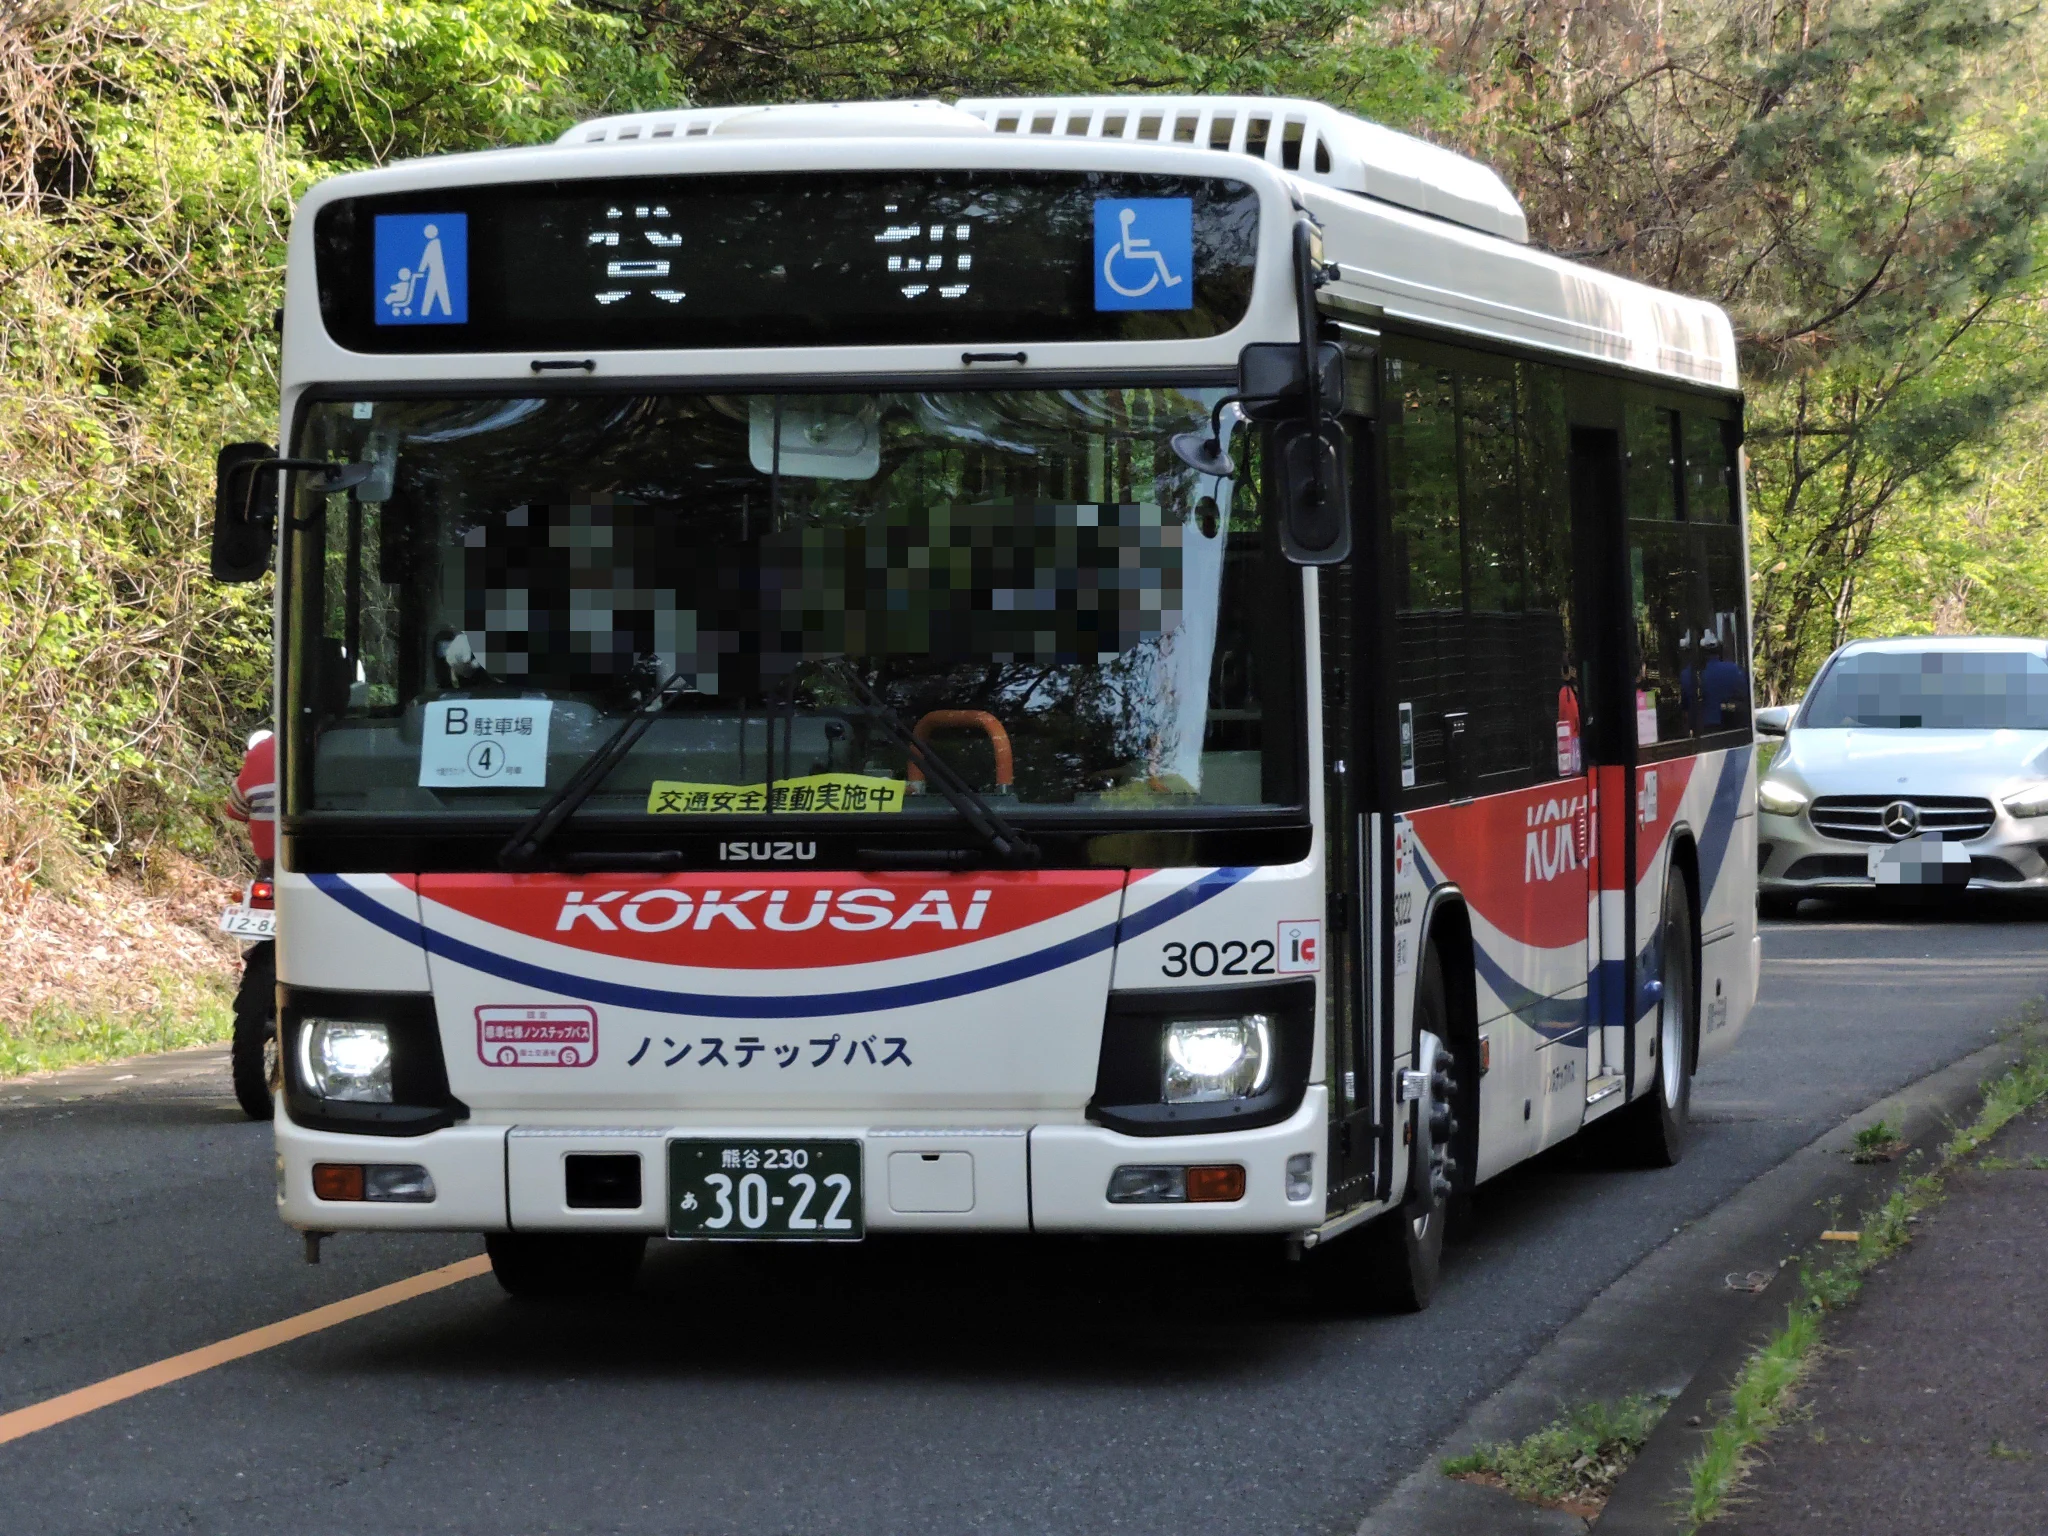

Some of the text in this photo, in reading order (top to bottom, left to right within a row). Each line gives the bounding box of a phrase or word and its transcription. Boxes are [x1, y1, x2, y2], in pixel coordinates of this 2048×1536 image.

[445, 707, 533, 736] B 駐車場
[656, 782, 895, 813] 交通安全運動実施中
[719, 841, 816, 861] ISUZU
[555, 888, 992, 932] KOKUSAI
[1162, 940, 1275, 977] 3022
[627, 1033, 913, 1069] ノンステップバス
[704, 1173, 852, 1229] 30-22
